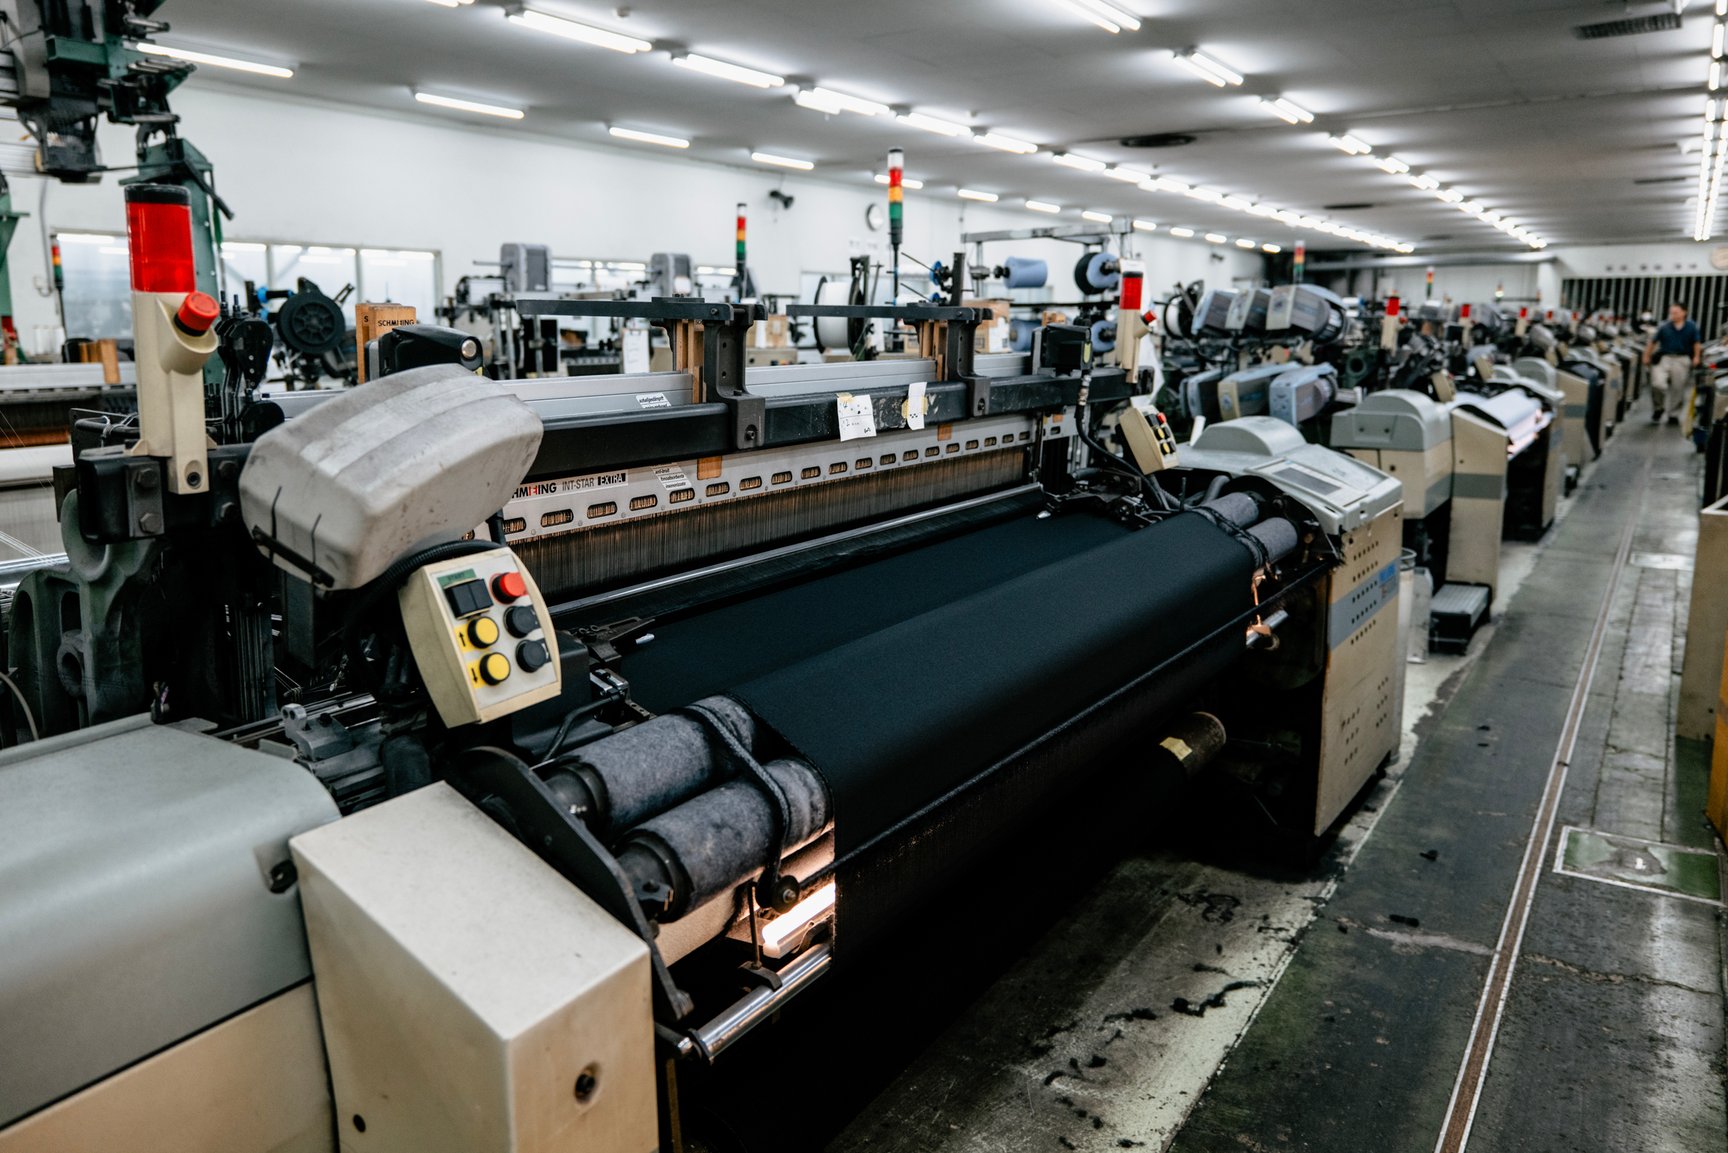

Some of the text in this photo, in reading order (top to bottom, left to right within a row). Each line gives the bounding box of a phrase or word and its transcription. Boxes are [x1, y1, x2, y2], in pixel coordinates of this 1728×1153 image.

[511, 473, 623, 499] HMEING INT-STAR EXTRA
